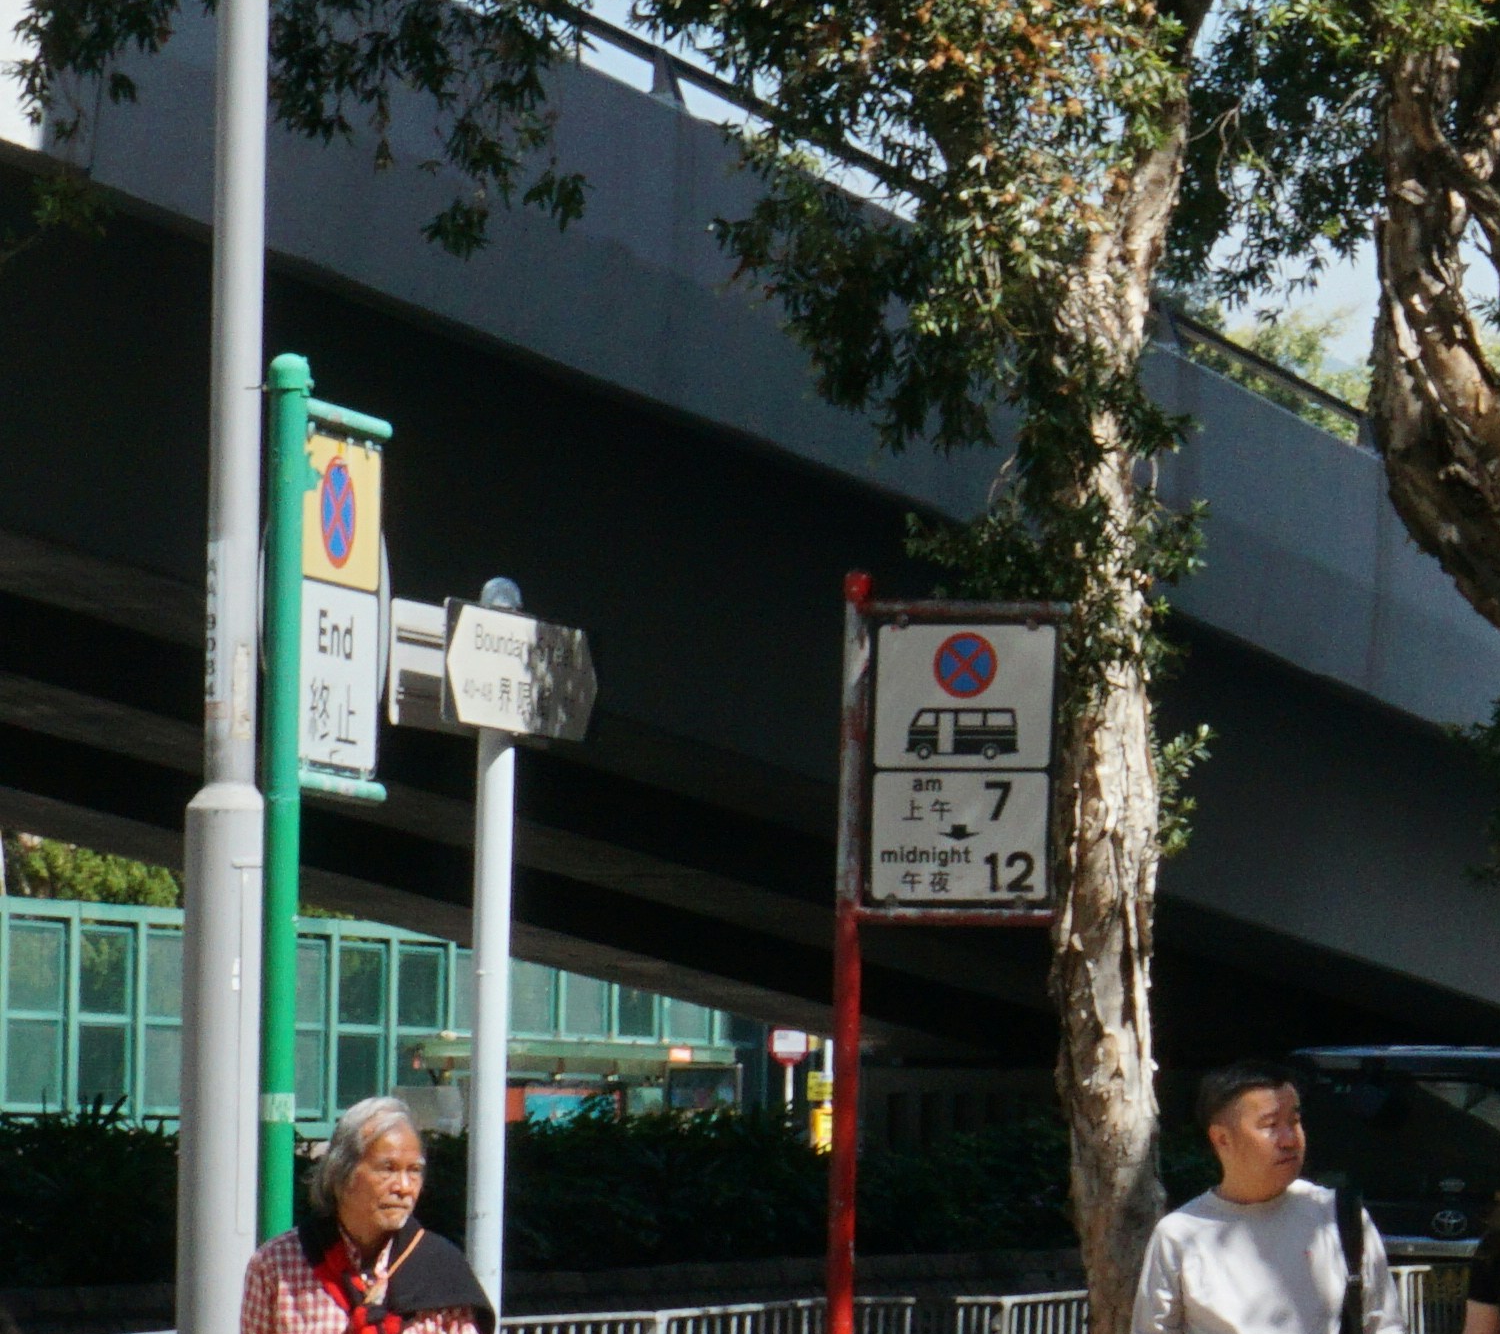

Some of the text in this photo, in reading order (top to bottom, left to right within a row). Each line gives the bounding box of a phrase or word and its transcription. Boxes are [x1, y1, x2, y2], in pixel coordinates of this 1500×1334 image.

[318, 608, 354, 660] End
[310, 678, 358, 746] 終止
[902, 798, 952, 821] 上午
[912, 778, 1012, 820] am 7
[880, 846, 1034, 893] midnight 12
[901, 871, 951, 892] 午夜
